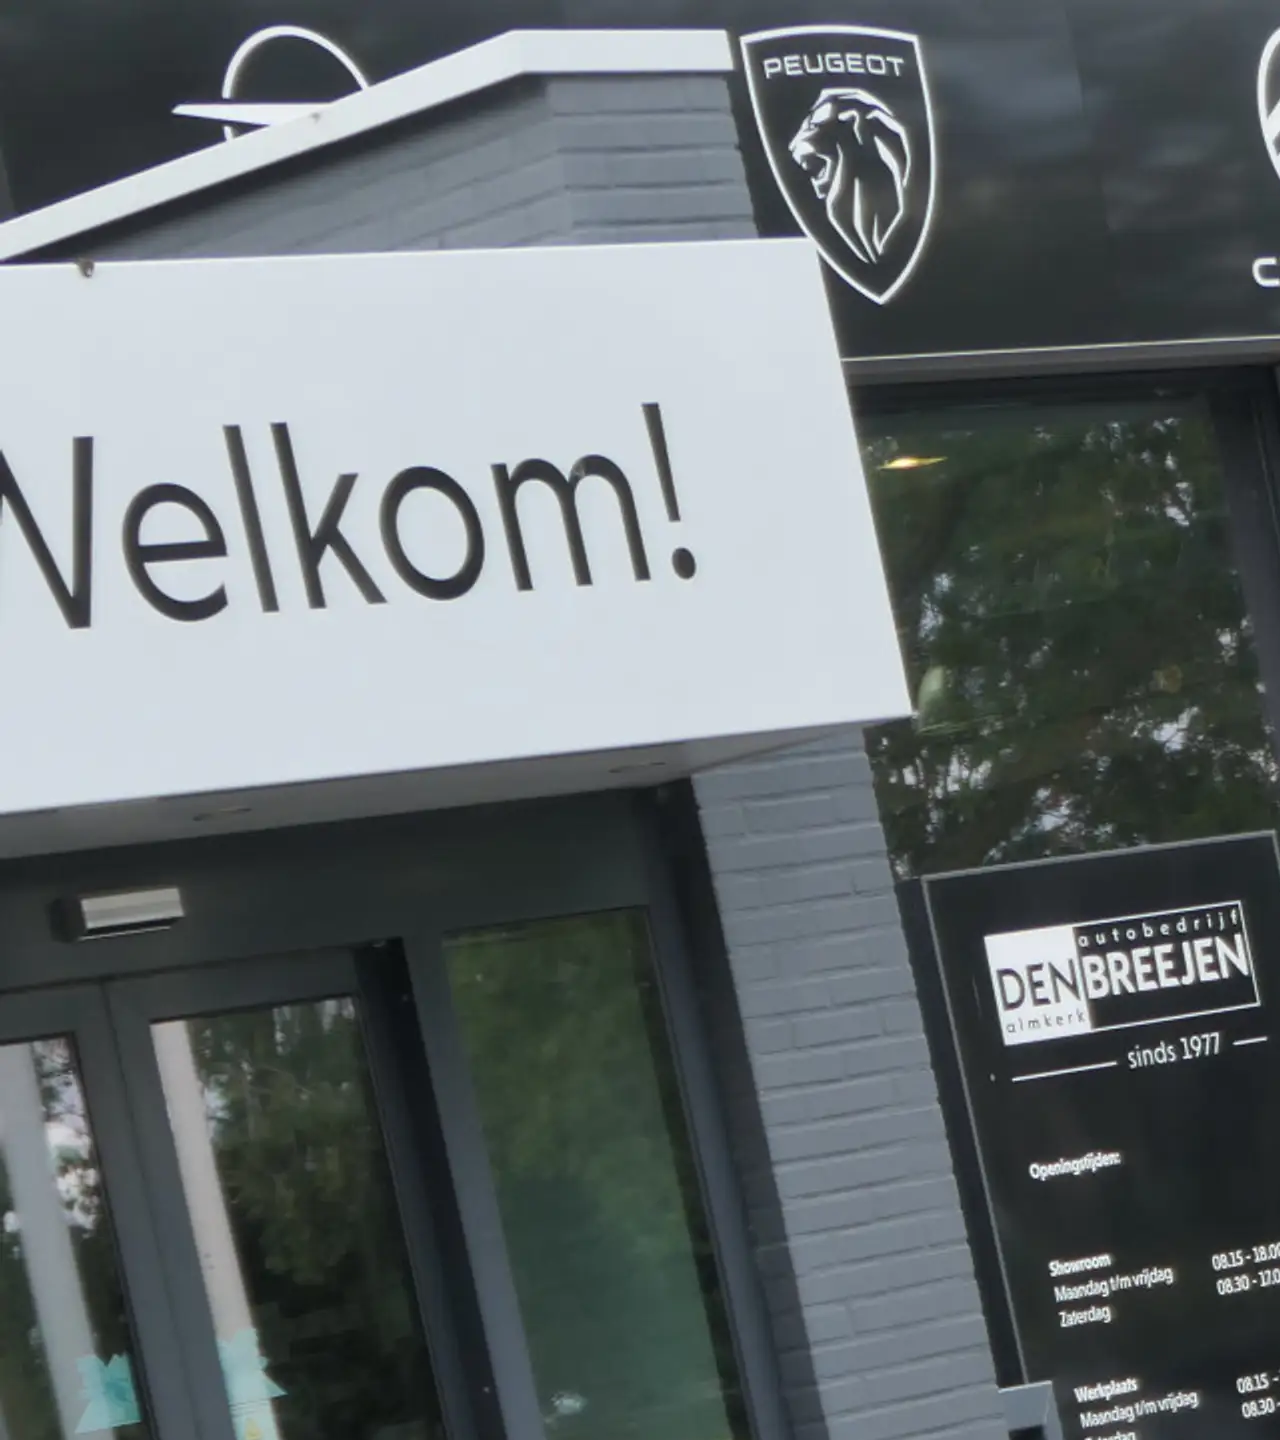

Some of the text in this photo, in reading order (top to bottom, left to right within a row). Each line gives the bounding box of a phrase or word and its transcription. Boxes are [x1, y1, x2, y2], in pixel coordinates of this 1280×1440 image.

[763, 53, 904, 79] PEUGEOT
[1078, 907, 1239, 948] autobedrijf
[1006, 1009, 1087, 1034] almkerk
[1127, 1032, 1221, 1069] sinds 1977
[1049, 1253, 1111, 1277] Showroom
[1212, 1250, 1244, 1271] 08.15
[1054, 1267, 1173, 1302] Maandag t/m vrijdag
[1216, 1274, 1250, 1295] 08.30
[1058, 1305, 1111, 1327] Zaterdag
[1074, 1378, 1138, 1403] Werkplaats
[1236, 1373, 1269, 1394] 08.15
[1080, 1392, 1198, 1429] Maandag t/m vrijdag
[1241, 1397, 1275, 1419] 08.30
